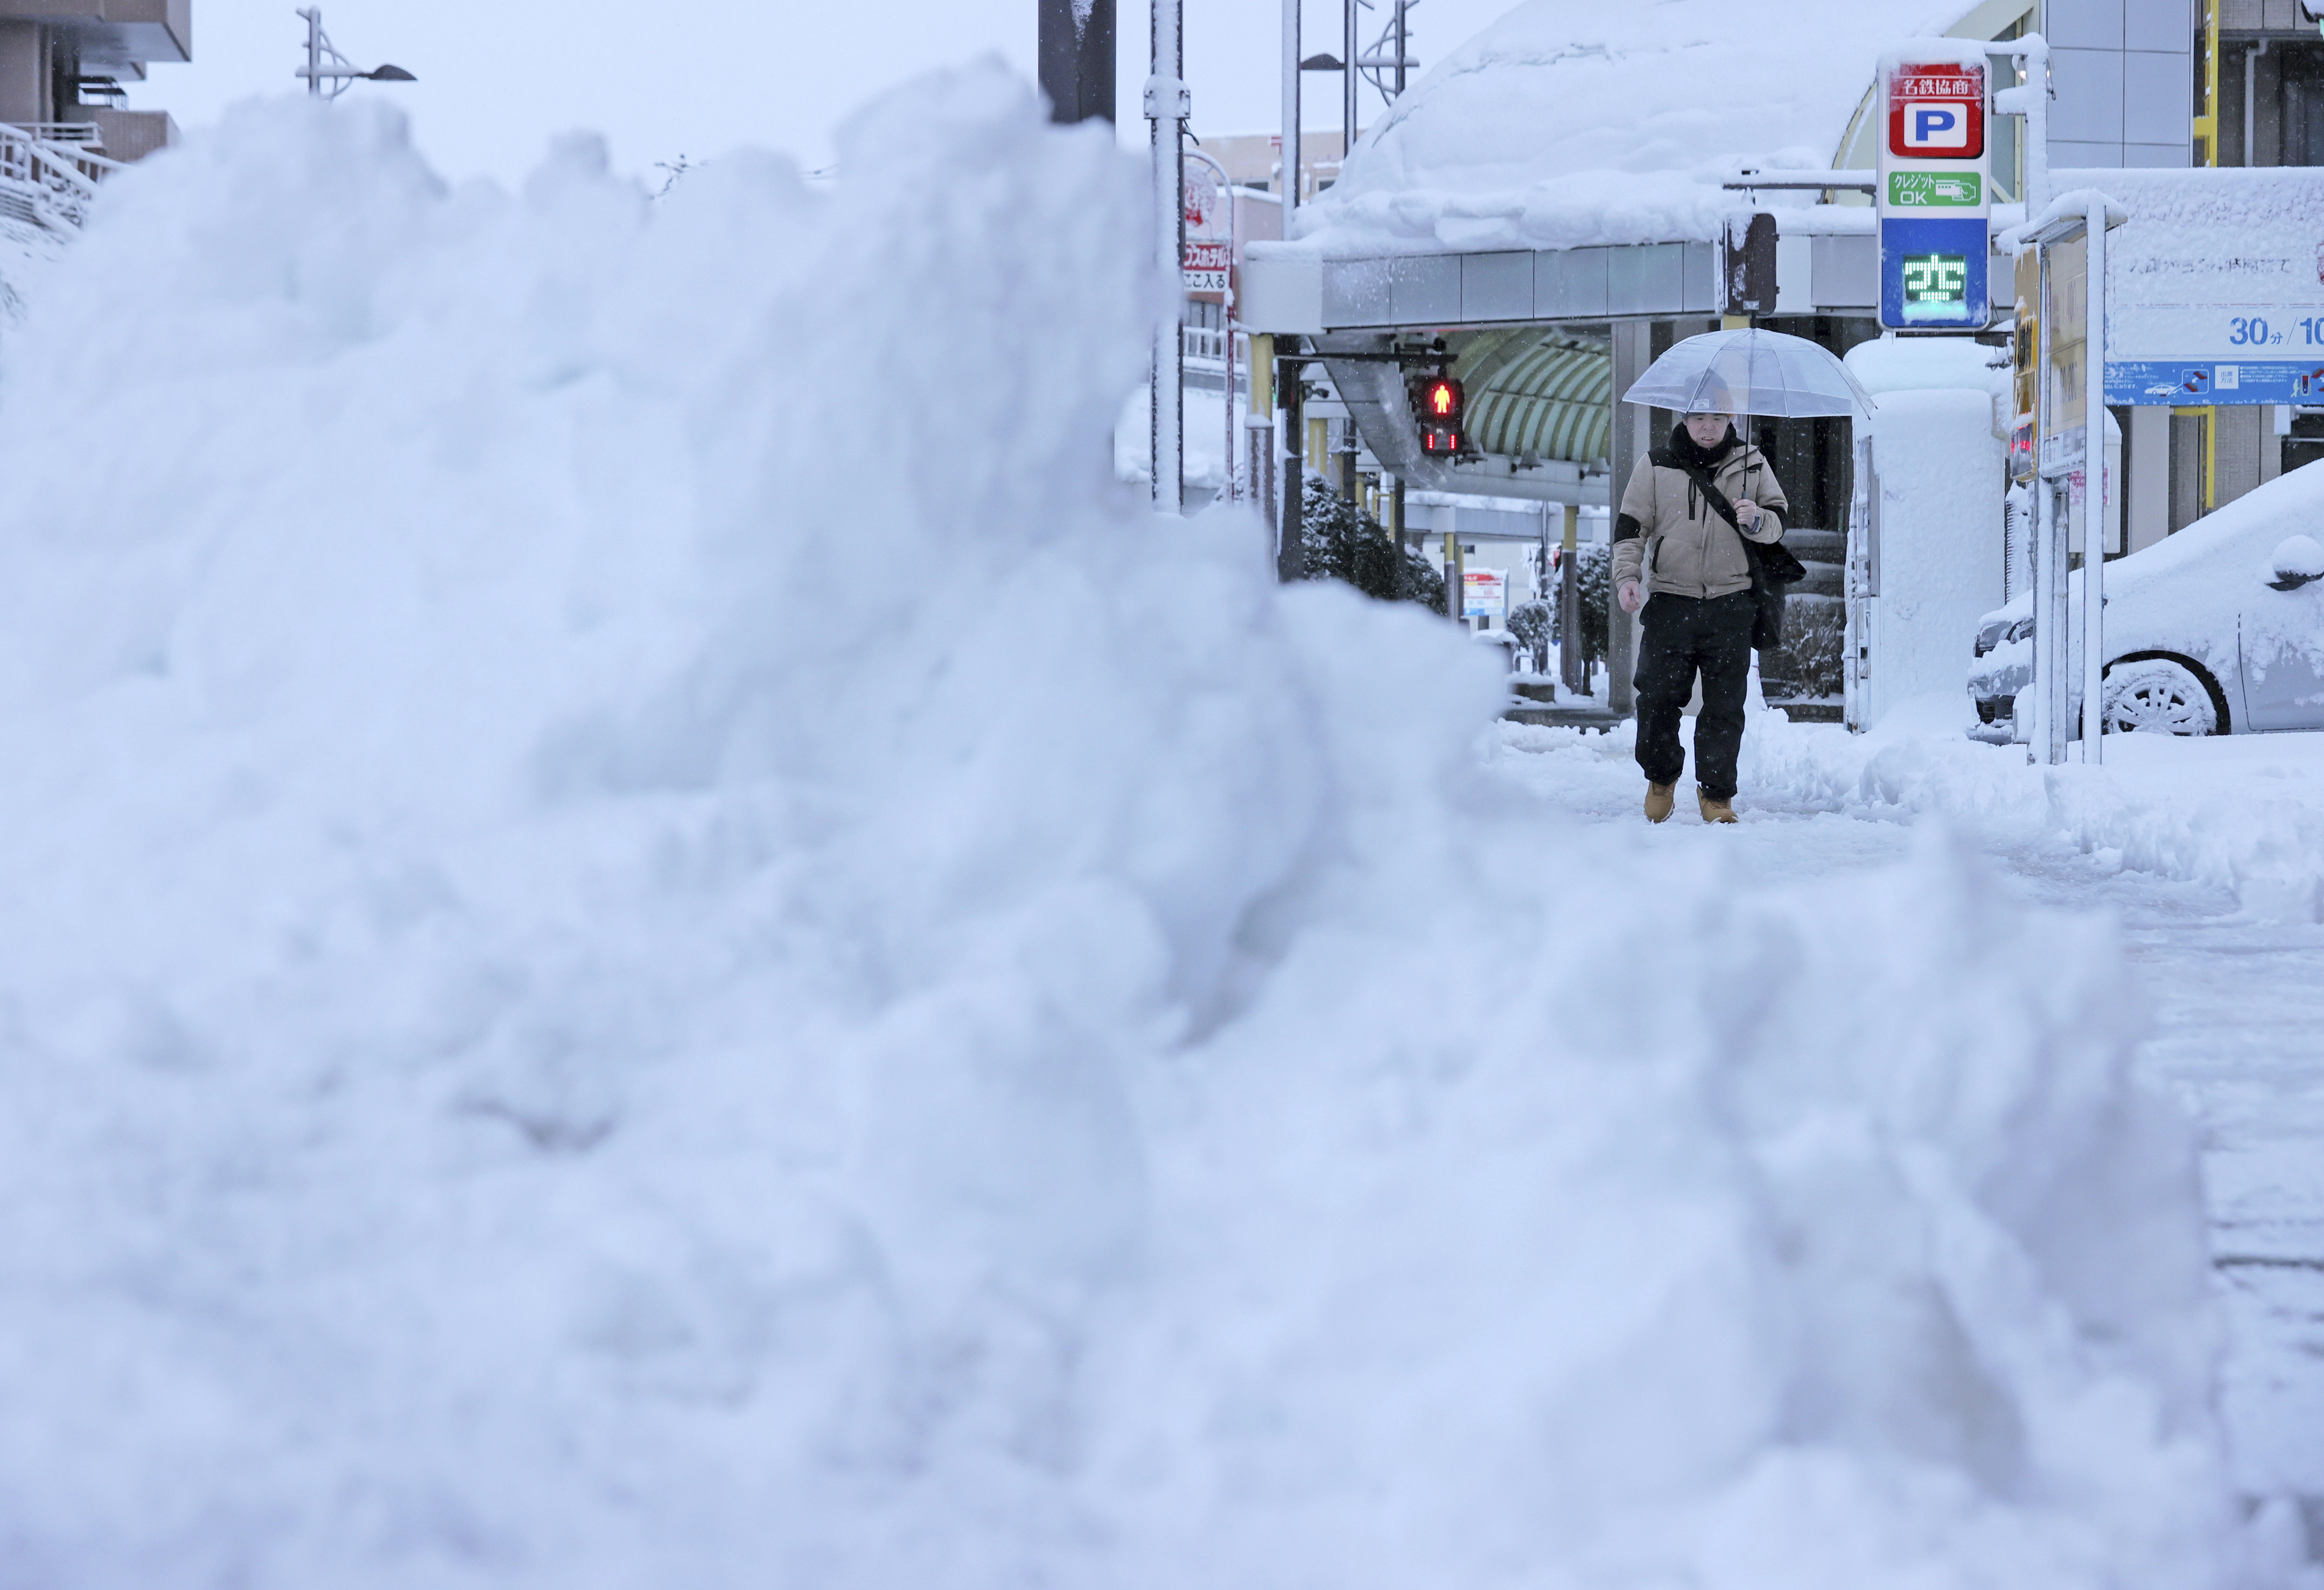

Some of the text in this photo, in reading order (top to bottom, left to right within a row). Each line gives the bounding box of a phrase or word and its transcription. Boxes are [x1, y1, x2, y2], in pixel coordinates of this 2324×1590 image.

[1903, 79, 1968, 95] 名鉄協商
[1916, 110, 1955, 141] P
[1894, 173, 1934, 189] クレジット
[1900, 191, 1928, 205] OK
